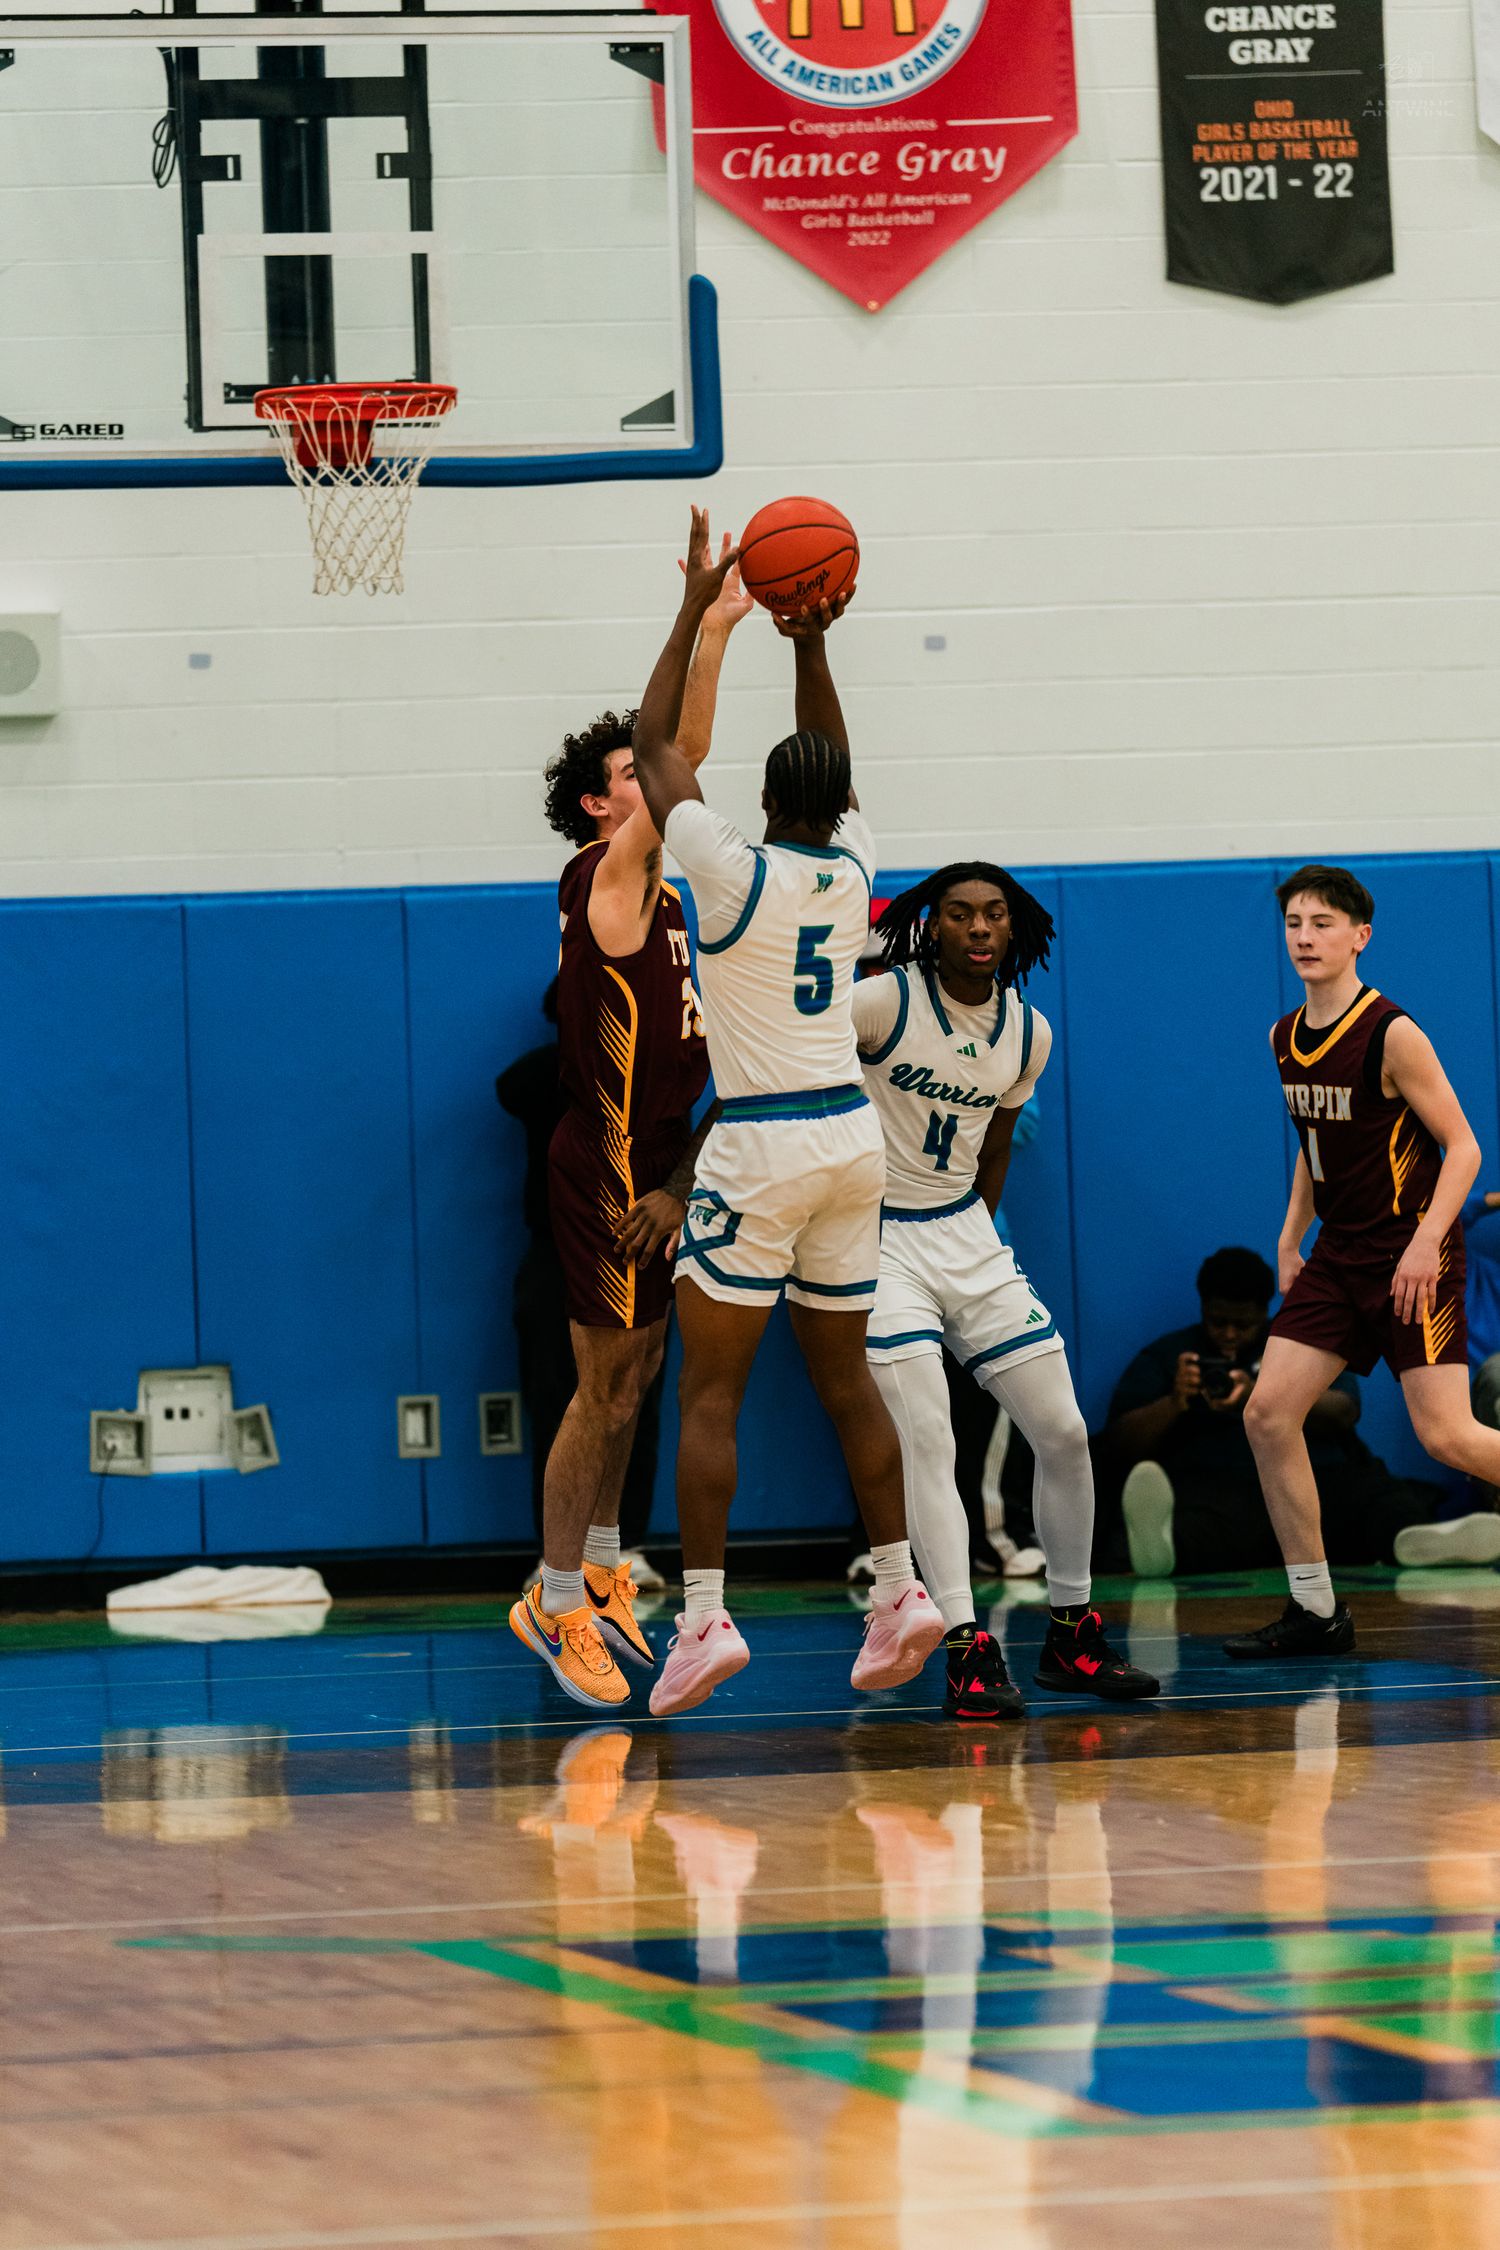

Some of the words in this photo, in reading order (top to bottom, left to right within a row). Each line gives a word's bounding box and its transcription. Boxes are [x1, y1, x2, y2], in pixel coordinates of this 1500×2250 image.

[1205, 5, 1336, 32] CHANCE
[745, 30, 780, 66] ALL
[782, 60, 894, 94] AMERICAN
[899, 23, 963, 82] GAMES
[1228, 37, 1314, 65] GRAY
[789, 116, 938, 138] Congratulations
[1196, 122, 1246, 141] GIRLS
[1249, 119, 1354, 139] BASKETBALL
[722, 143, 880, 179] Chance
[897, 141, 1007, 182] Gray
[1192, 143, 1254, 163] PLAYER
[1257, 142, 1278, 160] OF
[1283, 141, 1314, 160] THE
[1316, 139, 1360, 159] YEAR
[1200, 164, 1278, 202] 2021
[1312, 162, 1354, 199] 22
[763, 195, 859, 211] McDonald's
[862, 193, 888, 208] All
[890, 193, 972, 207] American
[801, 213, 843, 229] Girls
[847, 210, 935, 227] Basketball
[848, 230, 892, 246] 2022
[40, 423, 124, 436] GARED
[765, 569, 831, 607] Rawlings
[667, 928, 691, 967] TU
[794, 924, 834, 1016] 5
[889, 1063, 1000, 1109] Warrior
[922, 1109, 959, 1171] 4
[1307, 1125, 1325, 1183] 1
